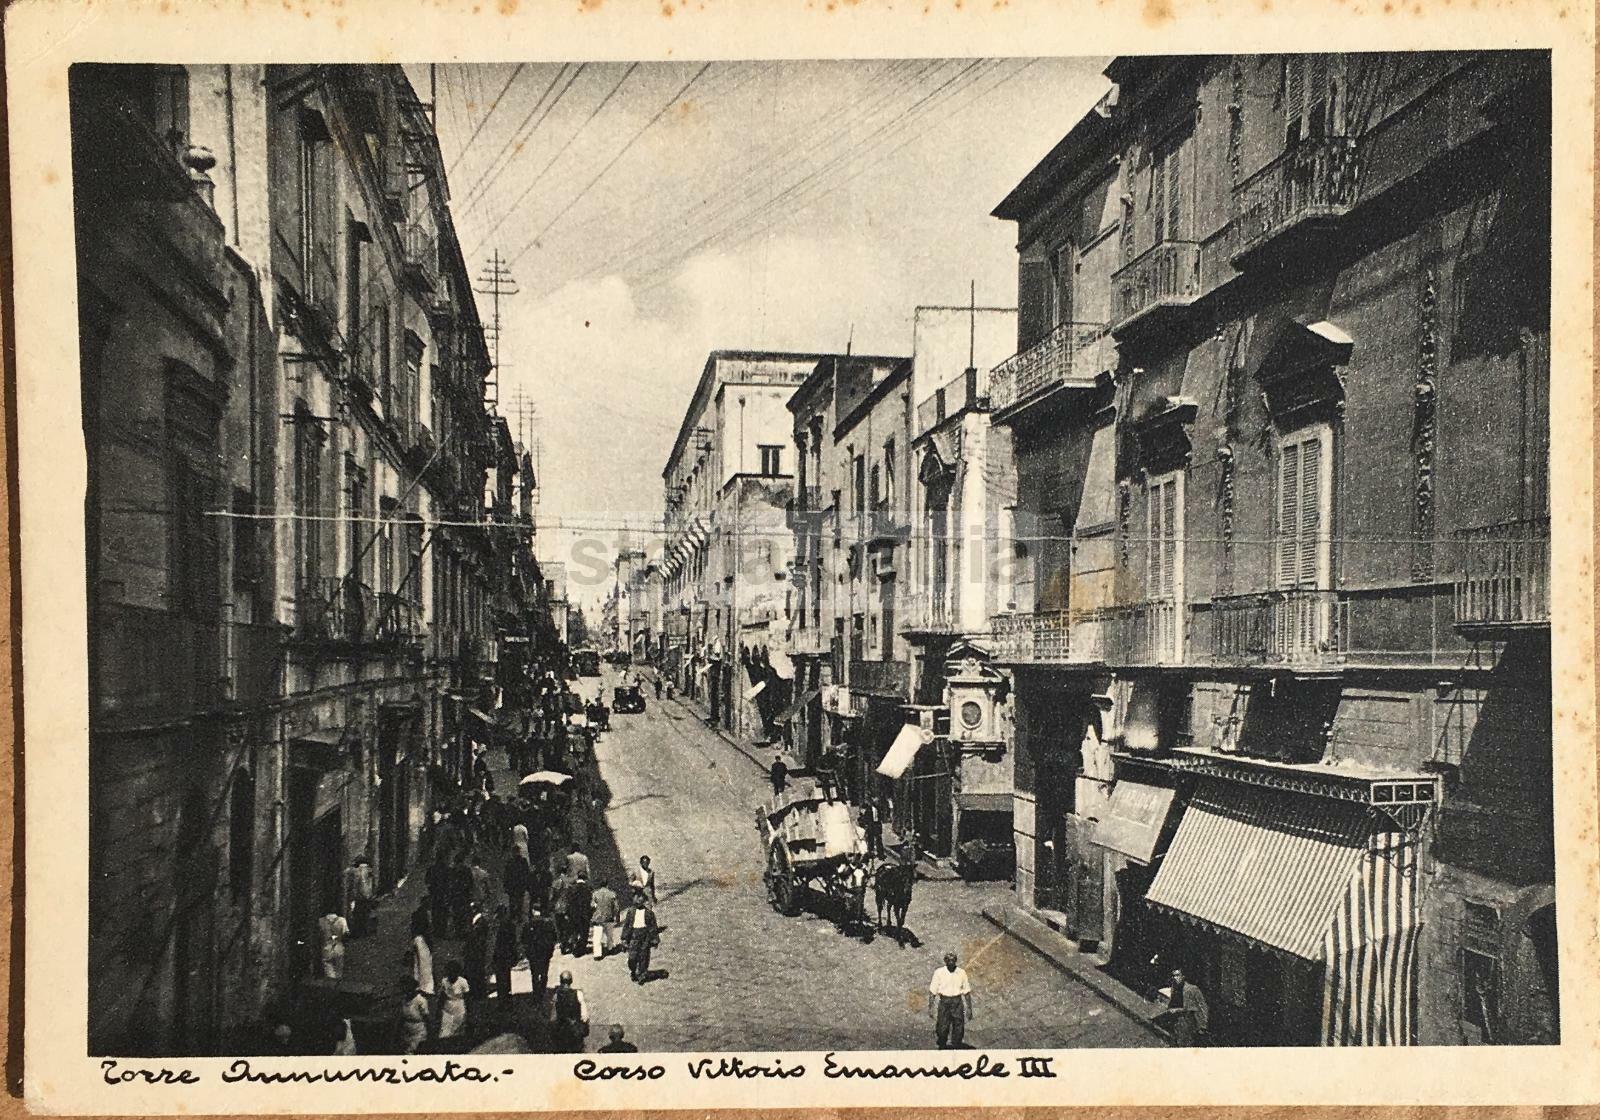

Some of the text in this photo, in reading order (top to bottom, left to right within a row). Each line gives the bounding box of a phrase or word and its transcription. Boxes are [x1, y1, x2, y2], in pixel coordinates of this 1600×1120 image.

[101, 1061, 200, 1084] Torre
[574, 1060, 666, 1080] Corso
[688, 1058, 806, 1080] Vittorio
[824, 1053, 1010, 1080] Emanuele
[1016, 1057, 1057, 1078] III
